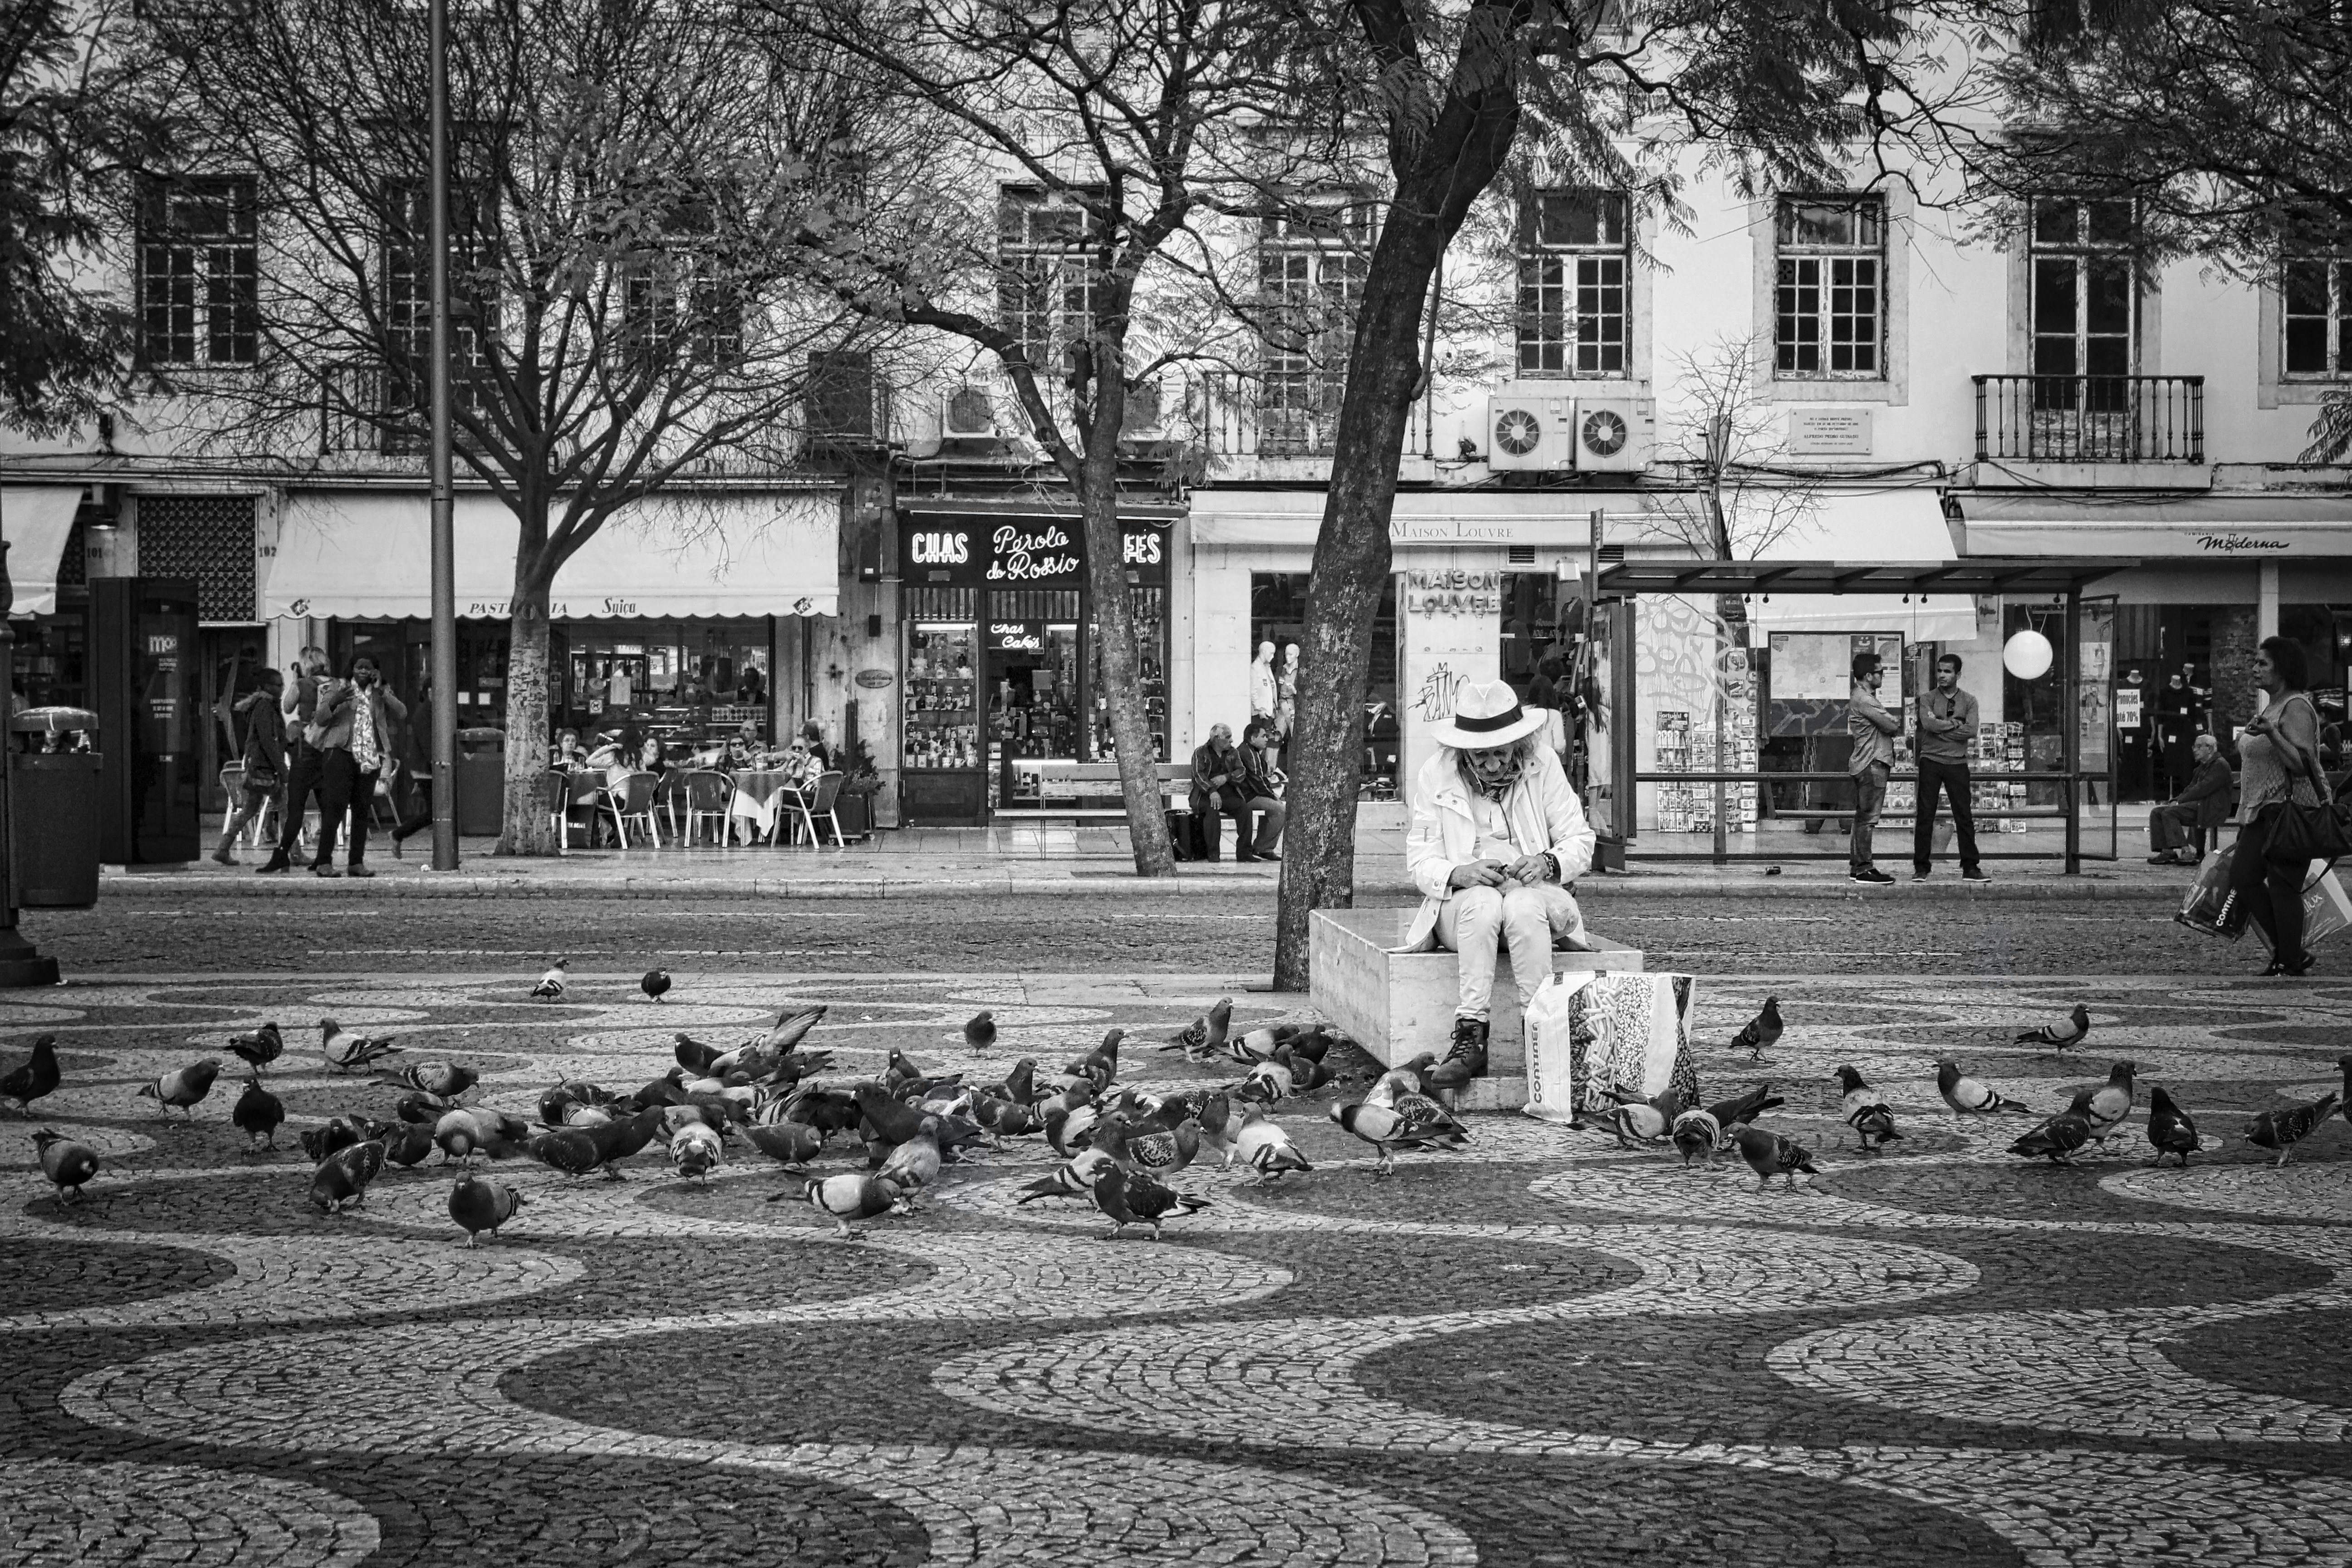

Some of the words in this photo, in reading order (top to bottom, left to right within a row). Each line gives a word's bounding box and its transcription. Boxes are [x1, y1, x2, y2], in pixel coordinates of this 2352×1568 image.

[2196, 535, 2290, 551] Moderna
[87, 547, 103, 559] 101
[259, 545, 277, 557] 102
[986, 560, 1006, 580] do
[1007, 551, 1080, 580] Rossio
[1408, 569, 1498, 589] MAISON
[469, 603, 568, 613] PASTIA
[1408, 594, 1501, 612] LOUVRE
[2117, 711, 2126, 722] até
[2126, 711, 2138, 722] 70%
